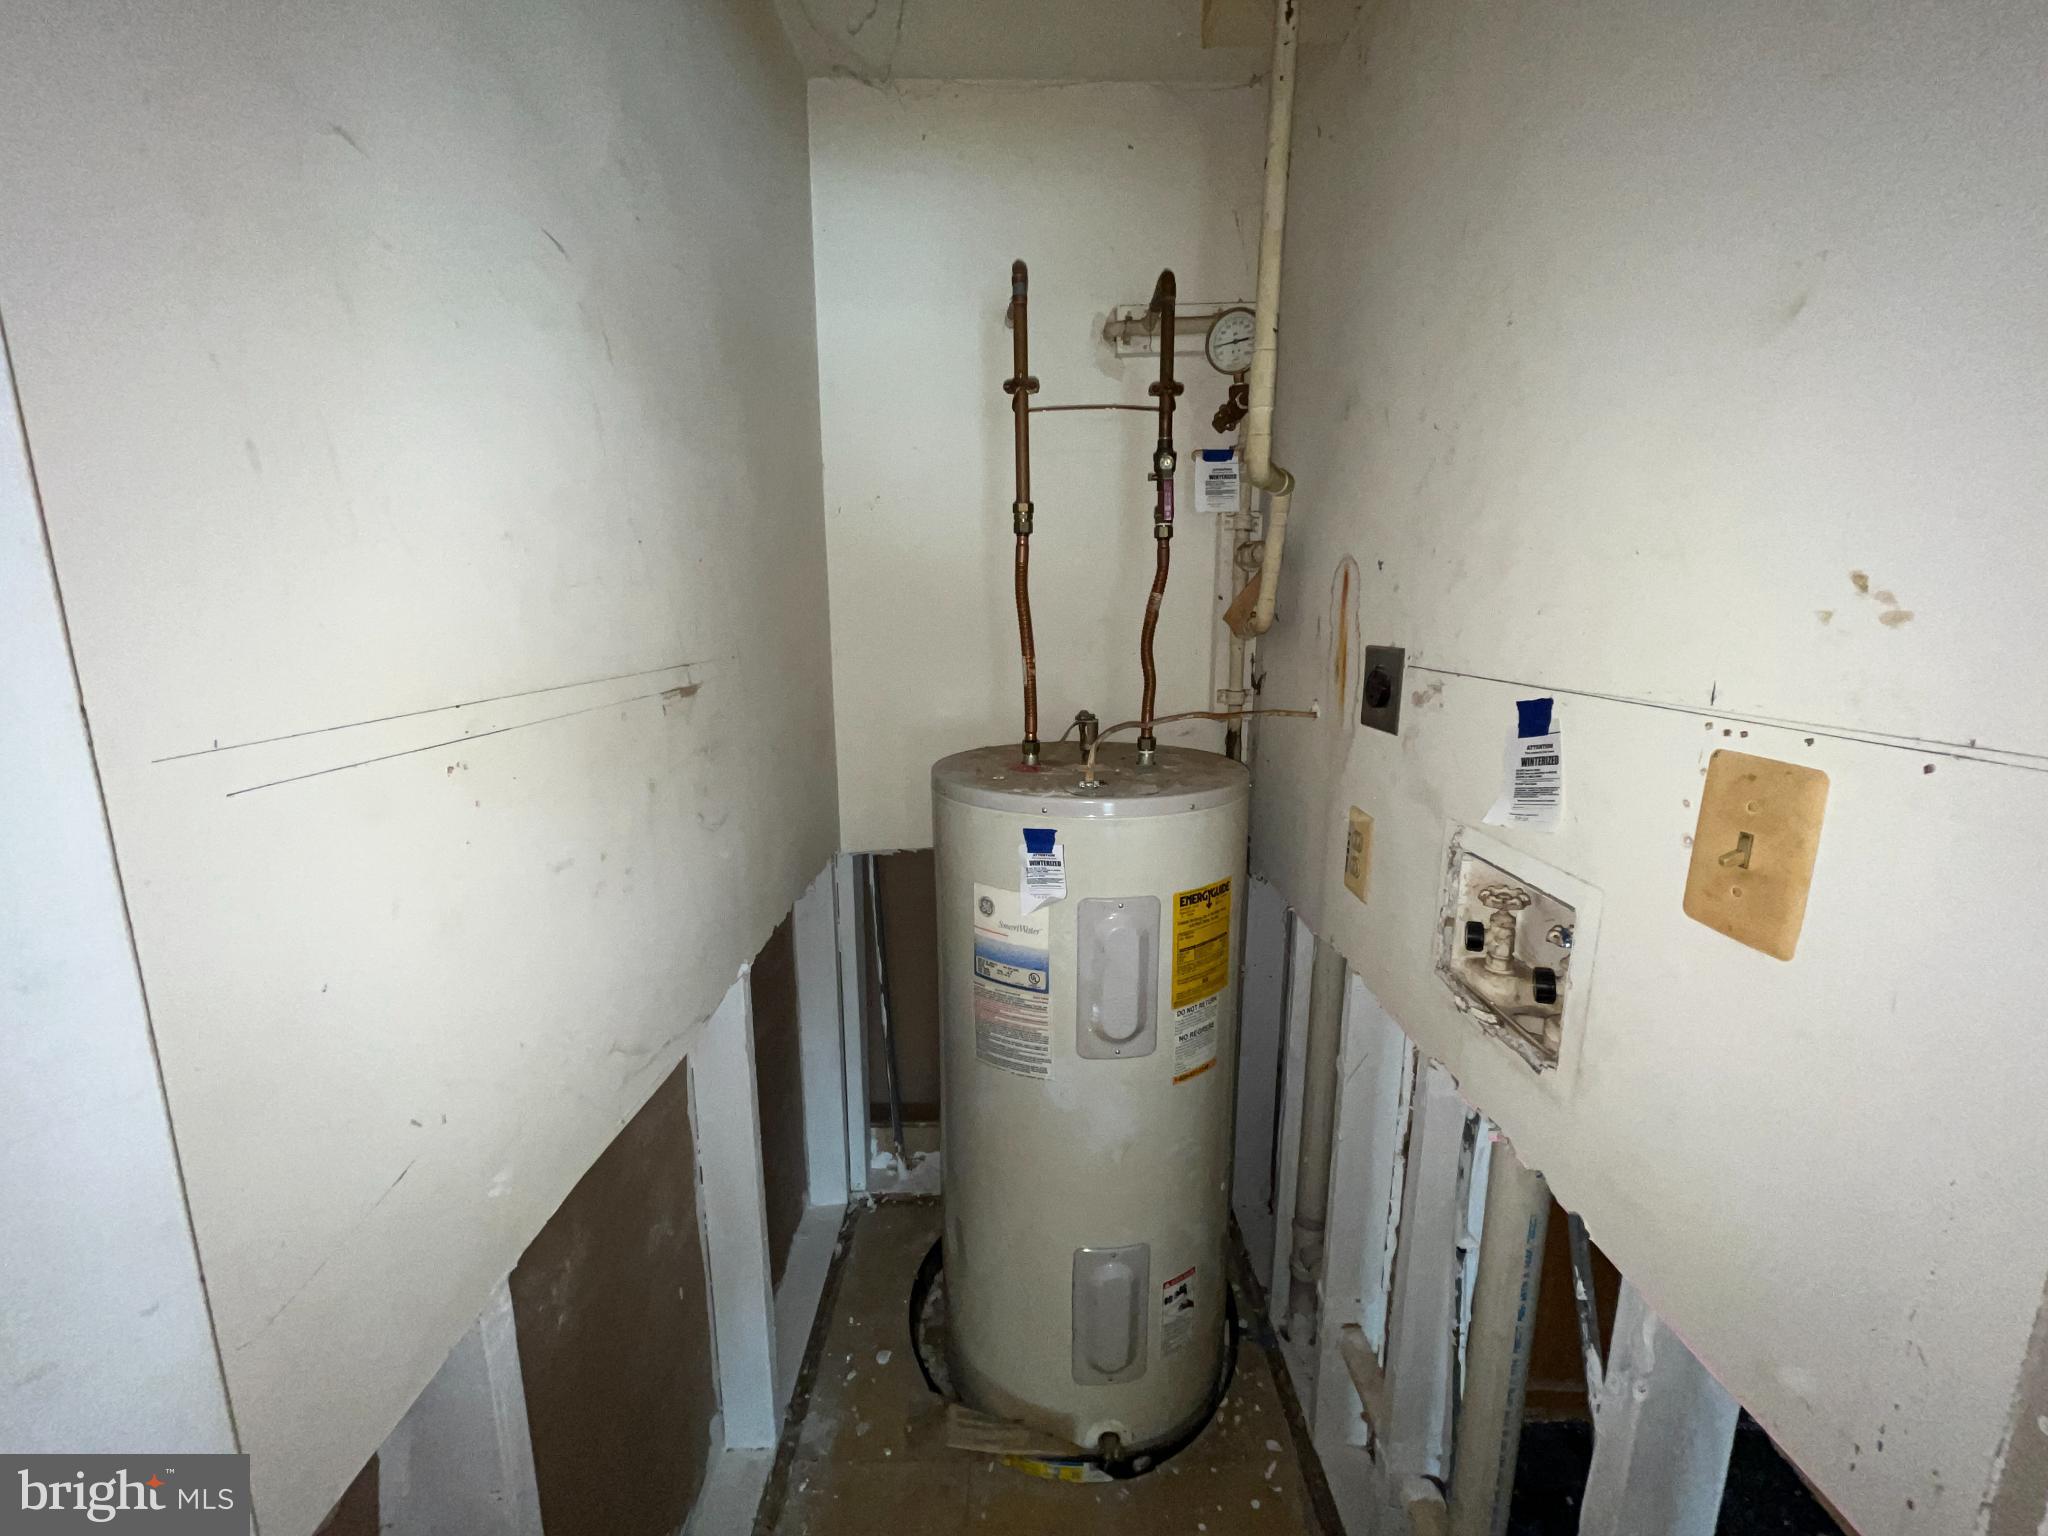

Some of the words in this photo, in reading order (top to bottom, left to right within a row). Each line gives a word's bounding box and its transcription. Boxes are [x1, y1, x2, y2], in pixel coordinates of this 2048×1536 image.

[1521, 755, 1560, 767] WINTERIZED
[1176, 1009, 1186, 1017] DO
[1187, 1004, 1198, 1013] NOT
[1178, 1033, 1189, 1043] NO
